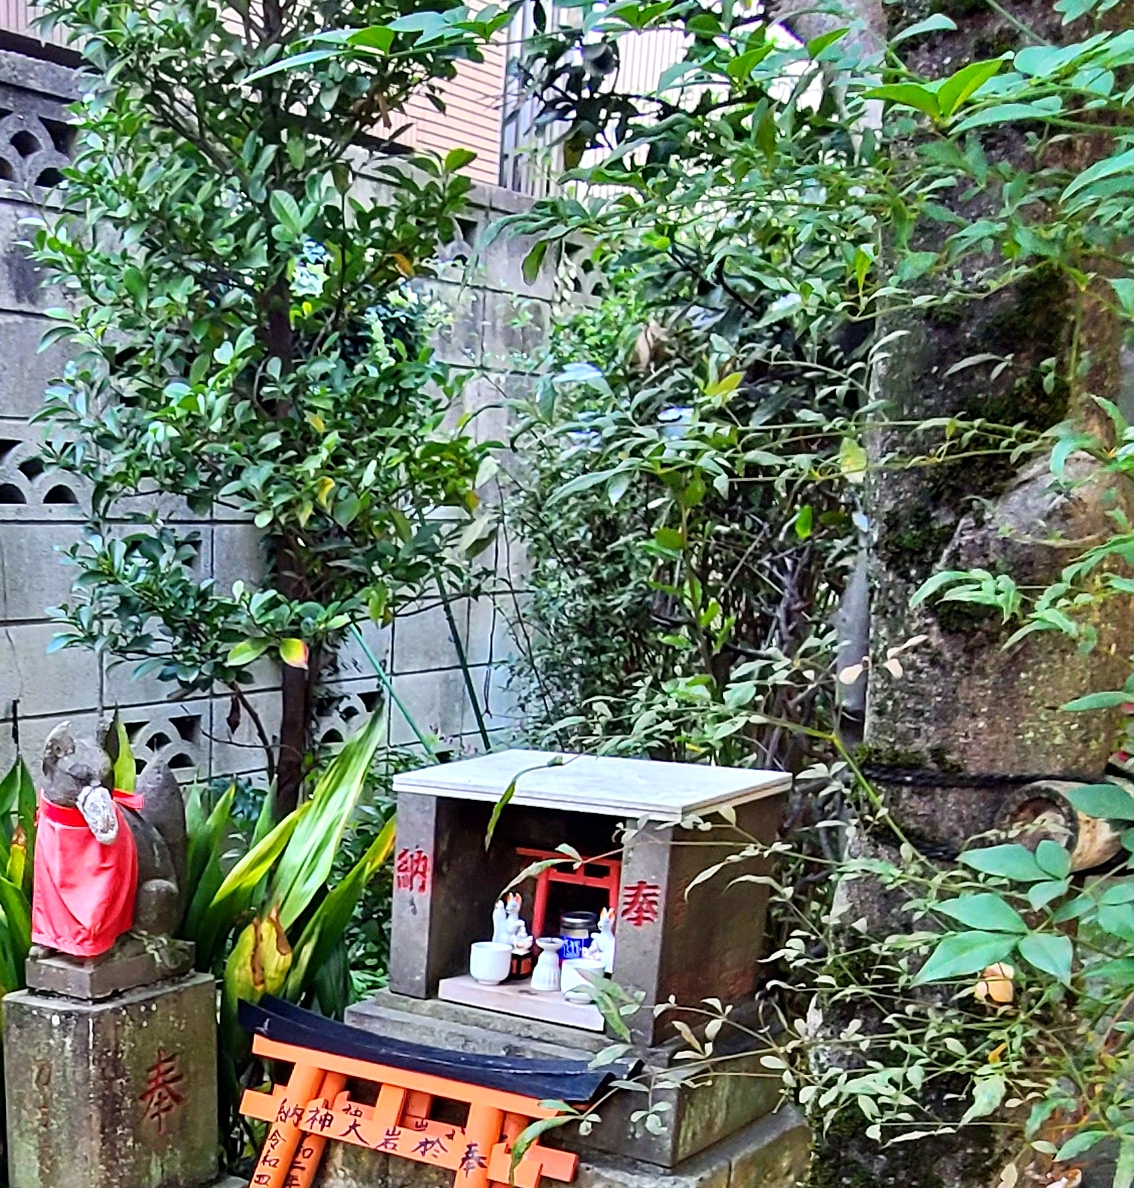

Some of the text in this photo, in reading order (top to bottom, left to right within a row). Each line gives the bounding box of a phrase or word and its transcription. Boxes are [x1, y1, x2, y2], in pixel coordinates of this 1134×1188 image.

[396, 848, 429, 895] 納
[621, 880, 660, 927] 奉
[139, 1050, 185, 1135] 奉
[459, 1141, 488, 1178] 奉
